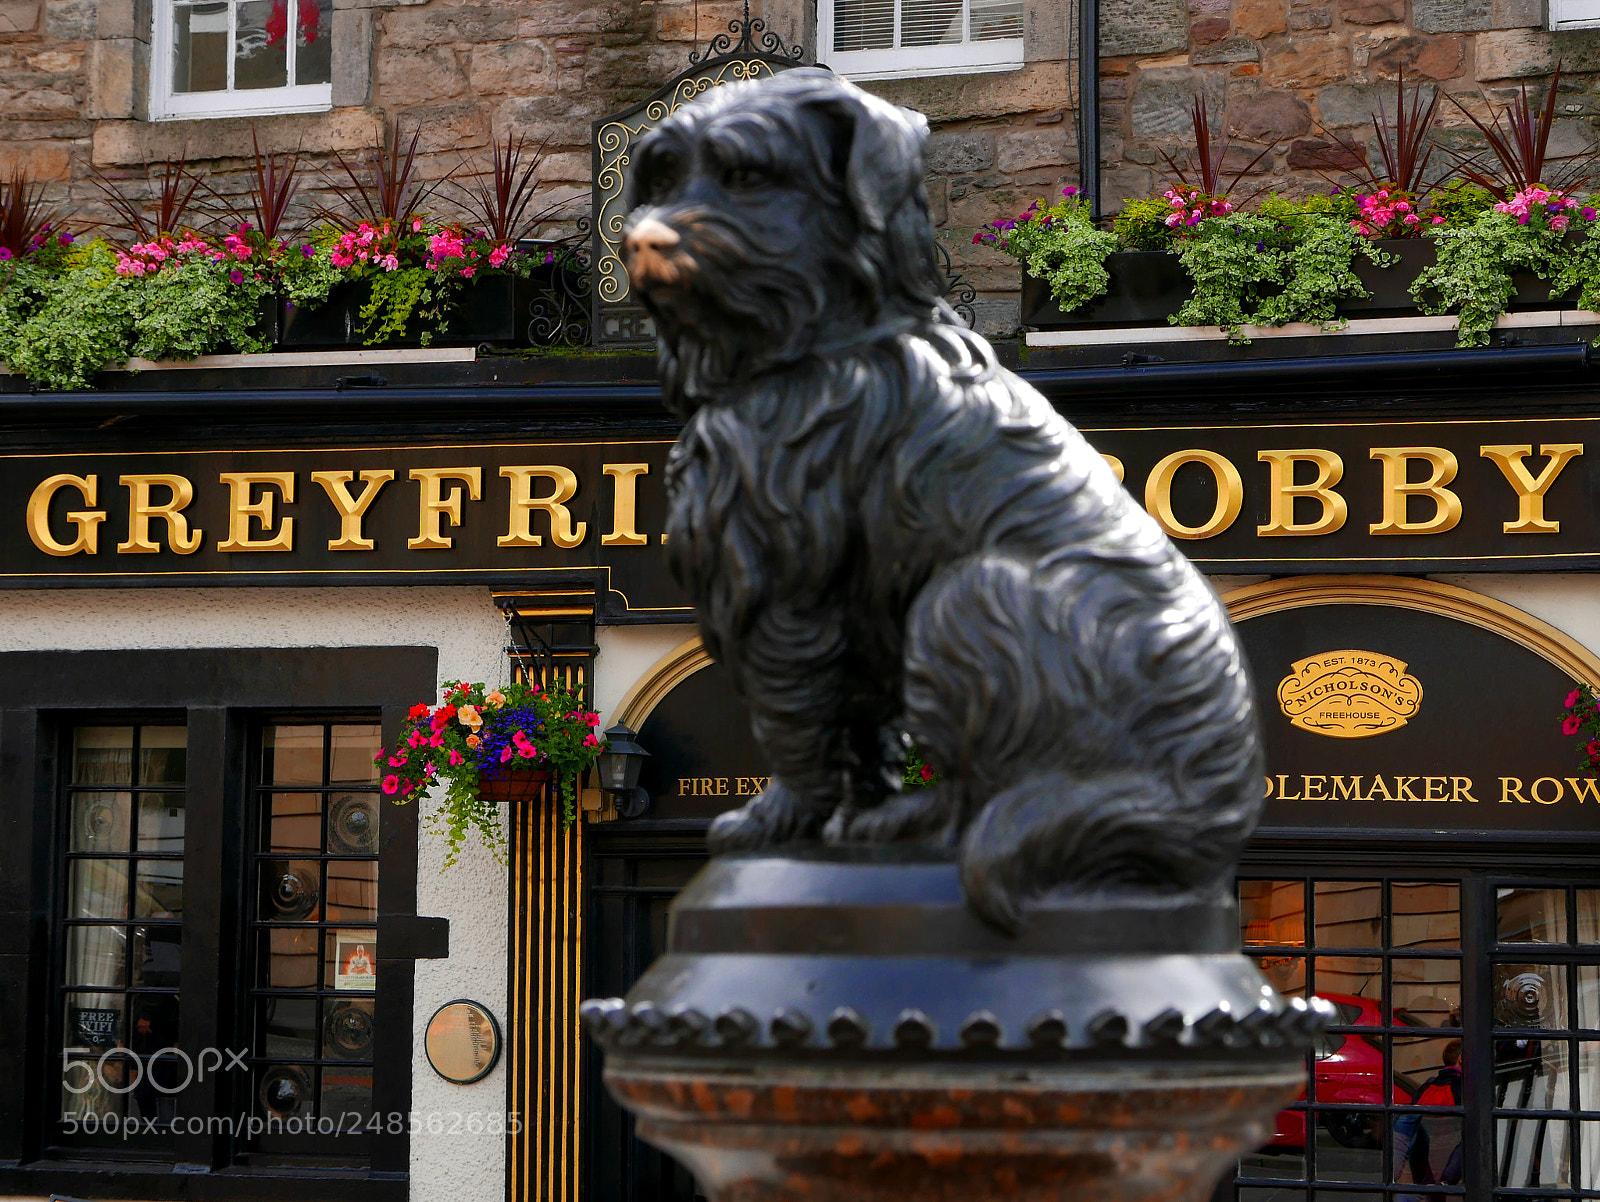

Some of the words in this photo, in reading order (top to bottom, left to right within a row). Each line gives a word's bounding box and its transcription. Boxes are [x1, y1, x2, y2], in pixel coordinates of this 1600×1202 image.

[26, 463, 669, 556] GREYFRI
[1100, 443, 1584, 540] OBBY
[1323, 657, 1347, 667] EST.
[1351, 657, 1376, 667] 1873
[1294, 680, 1405, 707] NICHOLSON'S
[1319, 711, 1380, 719] FREEHOUSE
[677, 777, 729, 796] FIRE
[1497, 776, 1600, 805] ROW
[80, 1011, 114, 1022] FREE
